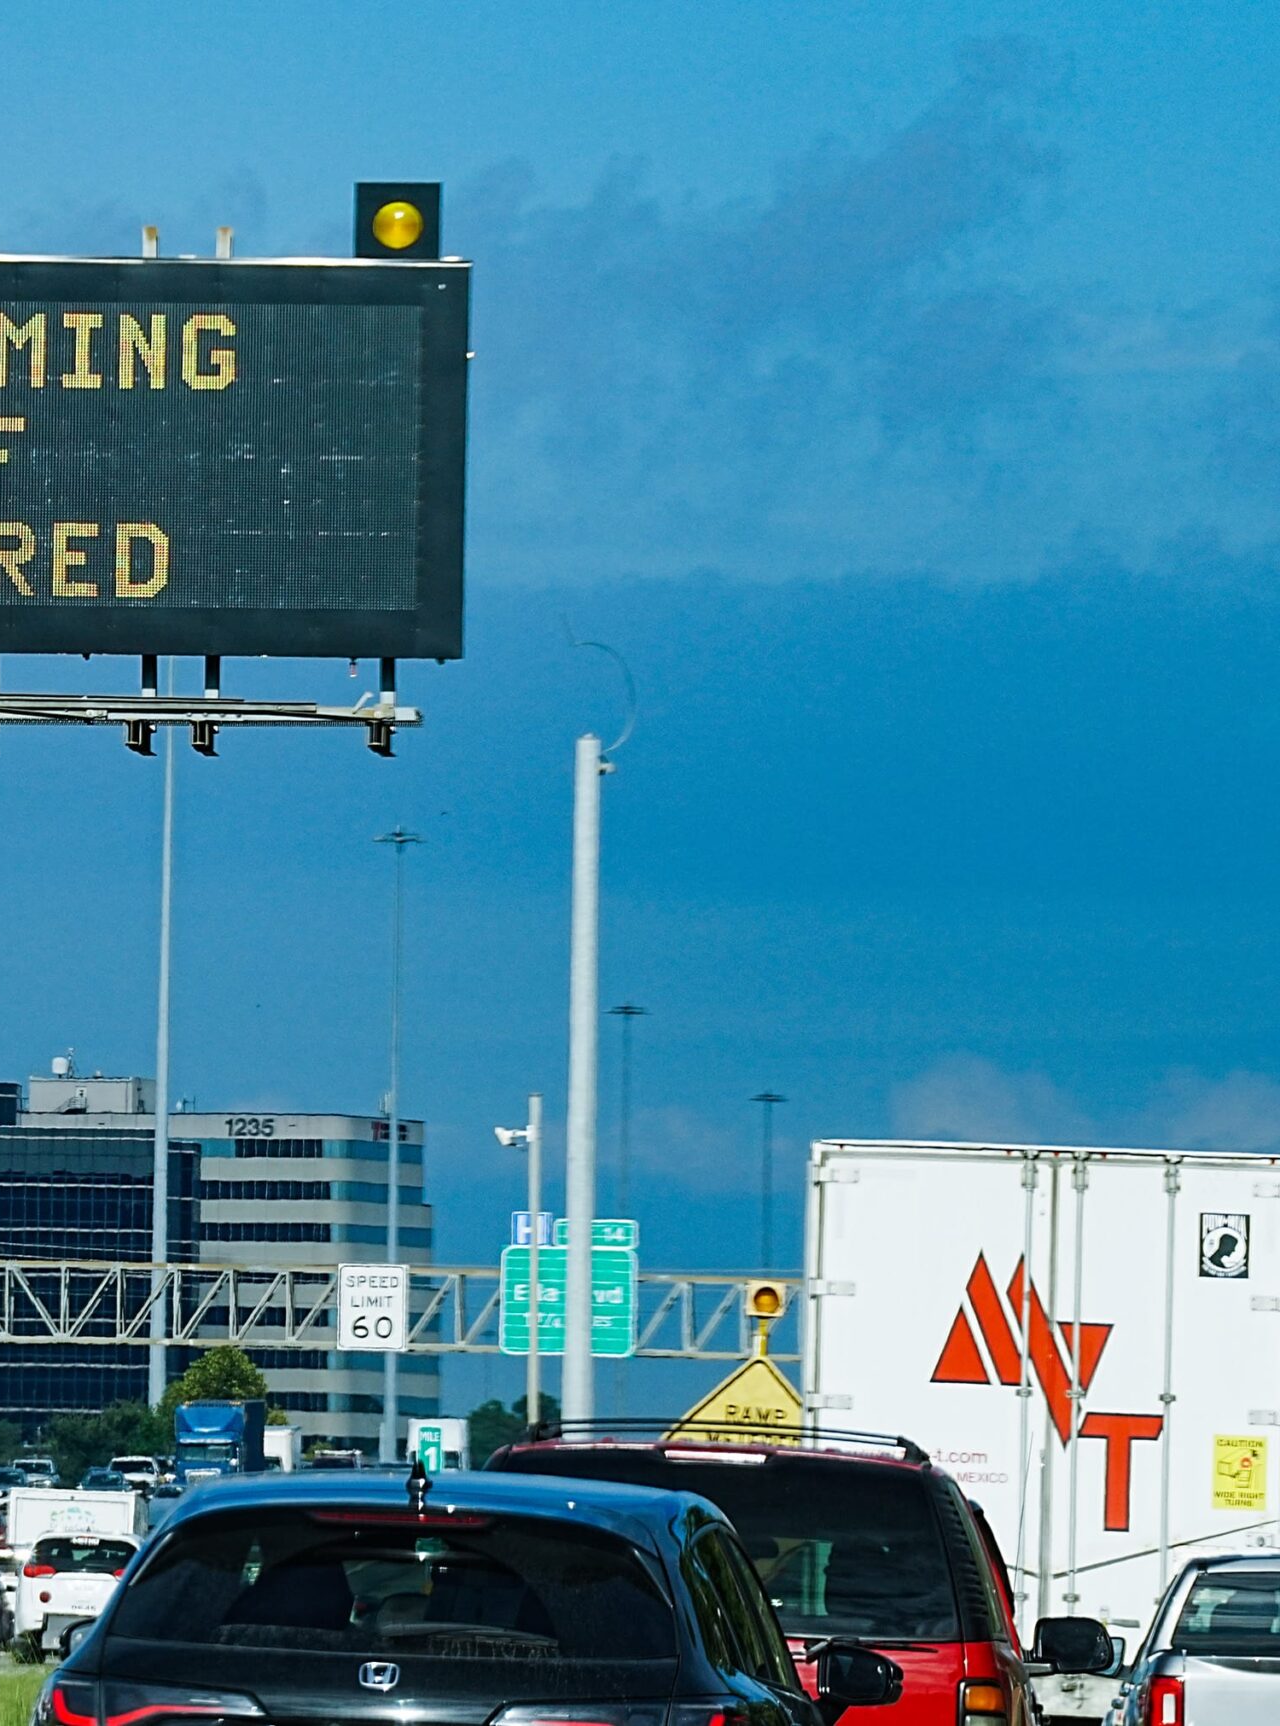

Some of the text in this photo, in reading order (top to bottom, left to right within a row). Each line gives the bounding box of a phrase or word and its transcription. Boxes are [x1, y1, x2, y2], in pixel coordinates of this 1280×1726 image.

[224, 1117, 275, 1137] 1235
[345, 1275, 399, 1289] SPEED
[351, 1295, 394, 1308] LIMIT
[353, 1315, 393, 1339] 60
[725, 1404, 788, 1425] RAMP
[420, 1431, 441, 1442] MILE
[1216, 1439, 1264, 1448] CAUTION
[424, 1446, 437, 1471] 1
[956, 1472, 1009, 1484] MEXICO
[1214, 1490, 1265, 1500] WIDE RIGHT
